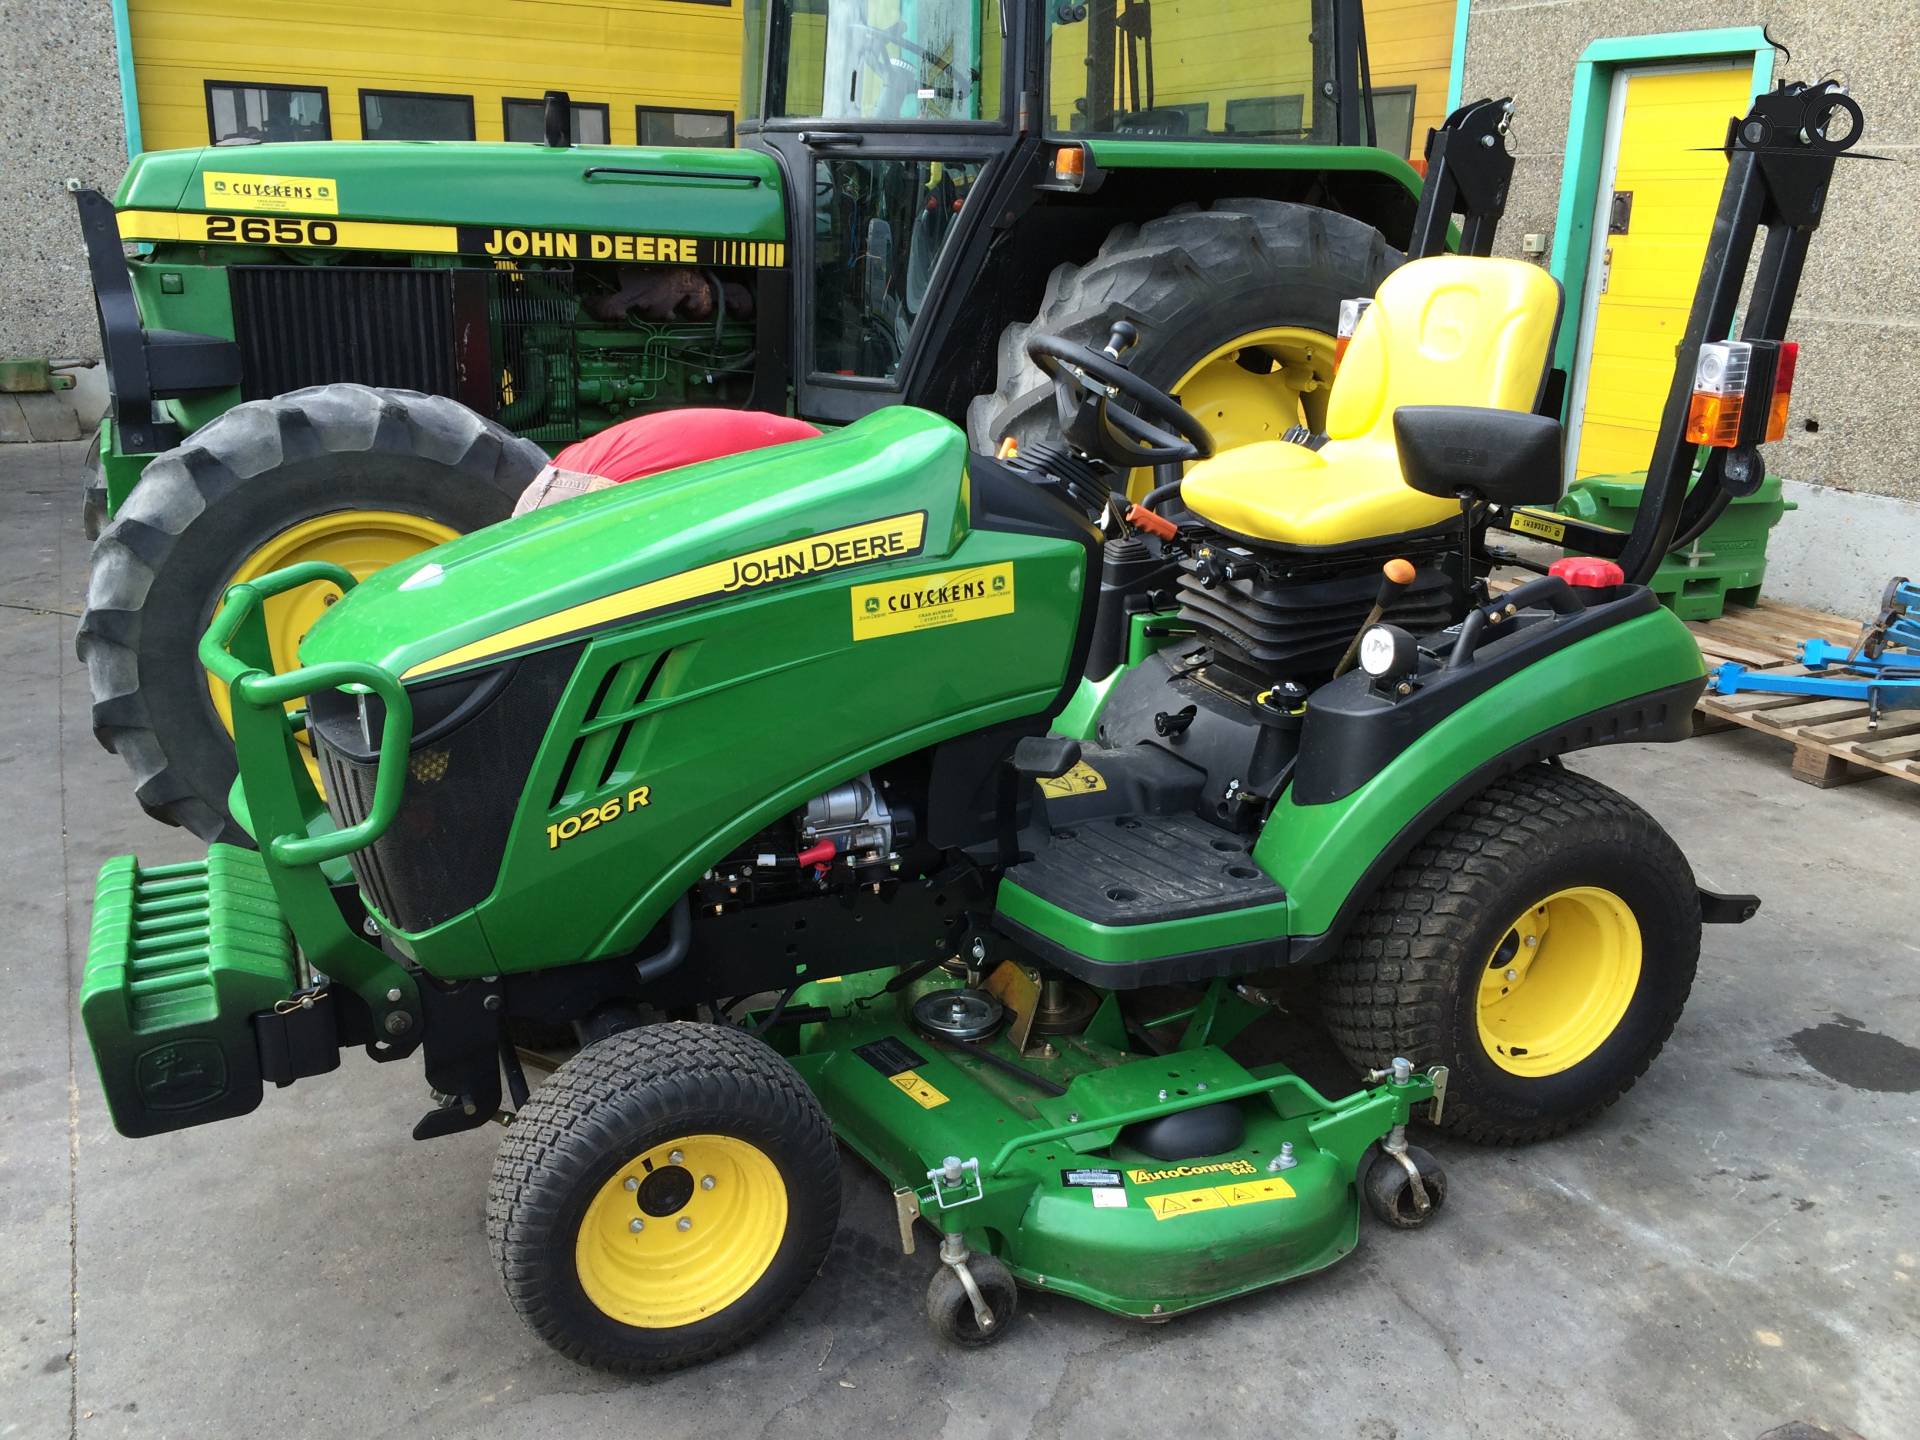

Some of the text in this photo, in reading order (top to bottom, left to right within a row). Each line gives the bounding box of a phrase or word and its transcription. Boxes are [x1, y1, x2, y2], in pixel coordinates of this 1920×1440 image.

[232, 183, 313, 198] CUYCKENS
[206, 216, 338, 246] 2650
[484, 229, 698, 263] JOHN DEERE
[723, 532, 905, 589] JOHN DEERE
[888, 580, 985, 612] CUYCKENS
[546, 785, 651, 850] 1026 R
[1136, 1159, 1252, 1183] AutoConnect
